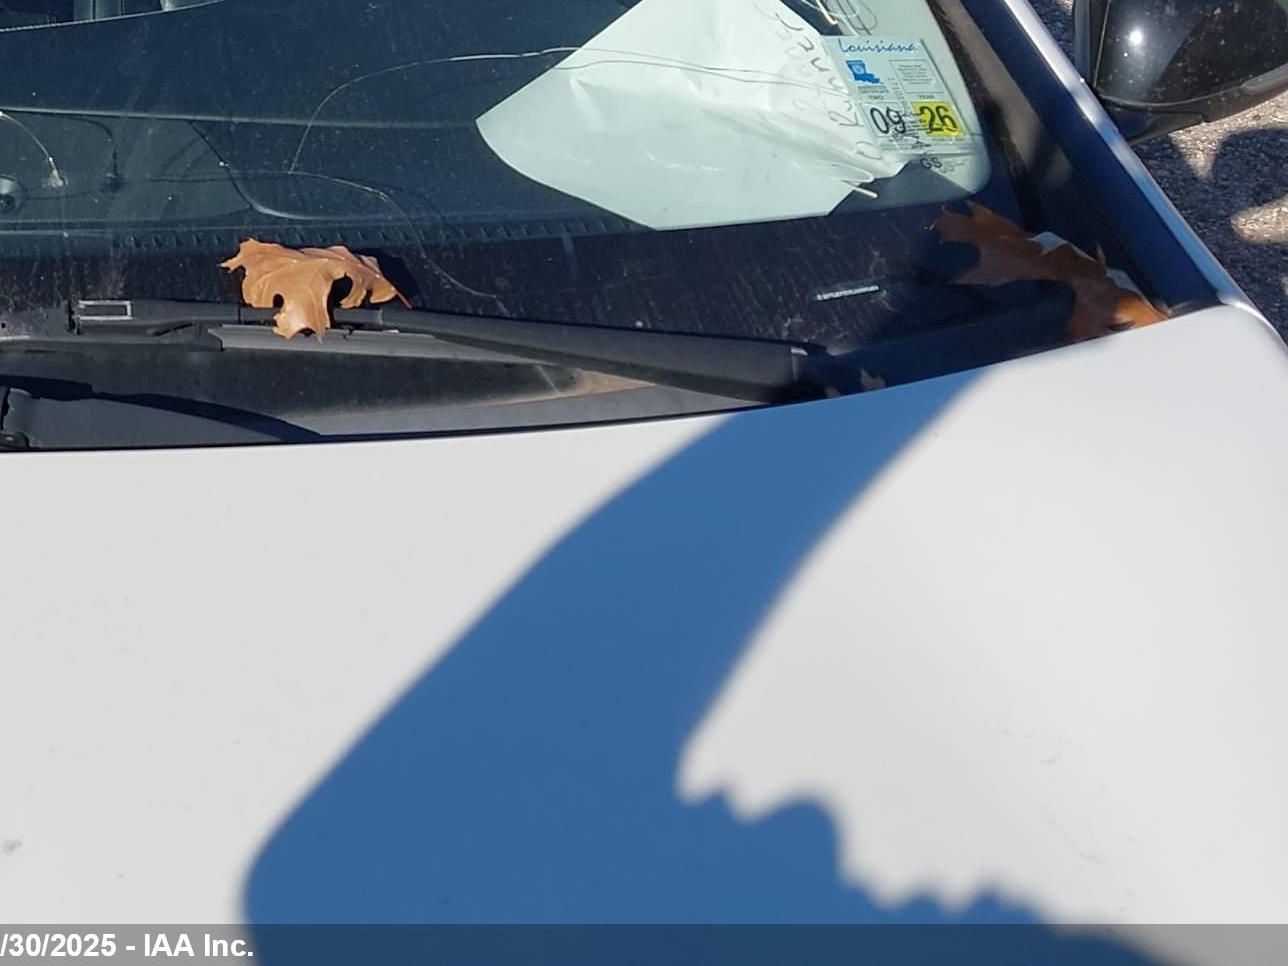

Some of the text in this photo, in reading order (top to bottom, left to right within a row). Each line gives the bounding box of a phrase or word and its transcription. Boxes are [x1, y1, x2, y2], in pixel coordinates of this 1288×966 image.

[838, 37, 919, 53] Louisiana
[870, 105, 958, 135] 09 26
